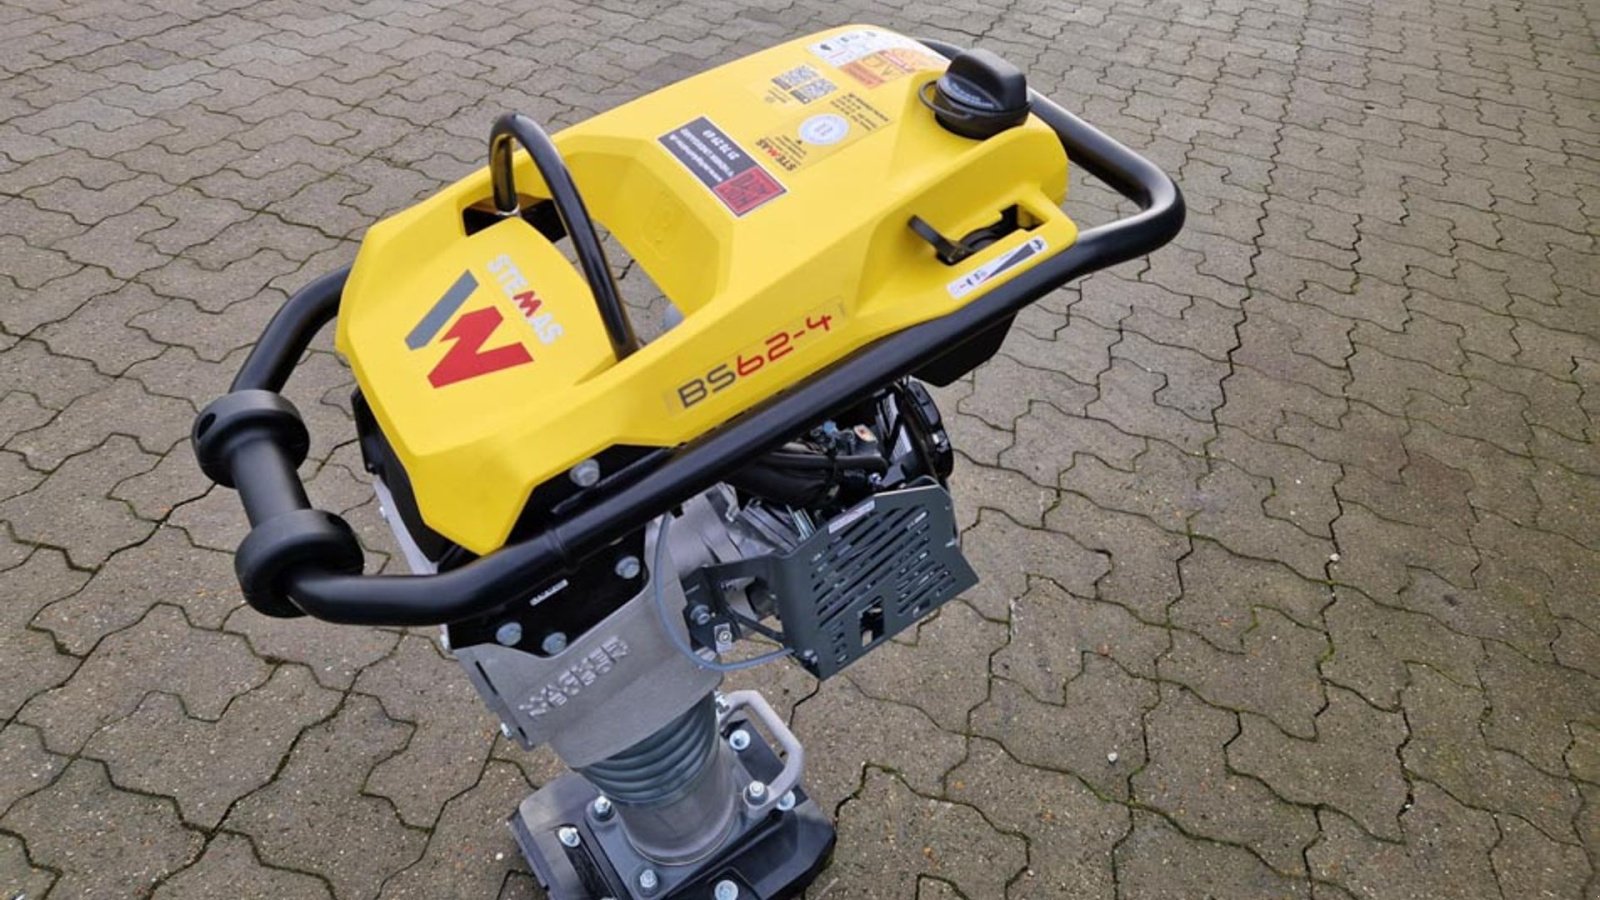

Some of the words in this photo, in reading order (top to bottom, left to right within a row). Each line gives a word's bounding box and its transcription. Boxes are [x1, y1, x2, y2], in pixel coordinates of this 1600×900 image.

[756, 138, 798, 172] STEMAS
[487, 253, 565, 345] STEMAS
[677, 314, 833, 408] BS62-4
[518, 636, 629, 708] WACKER
